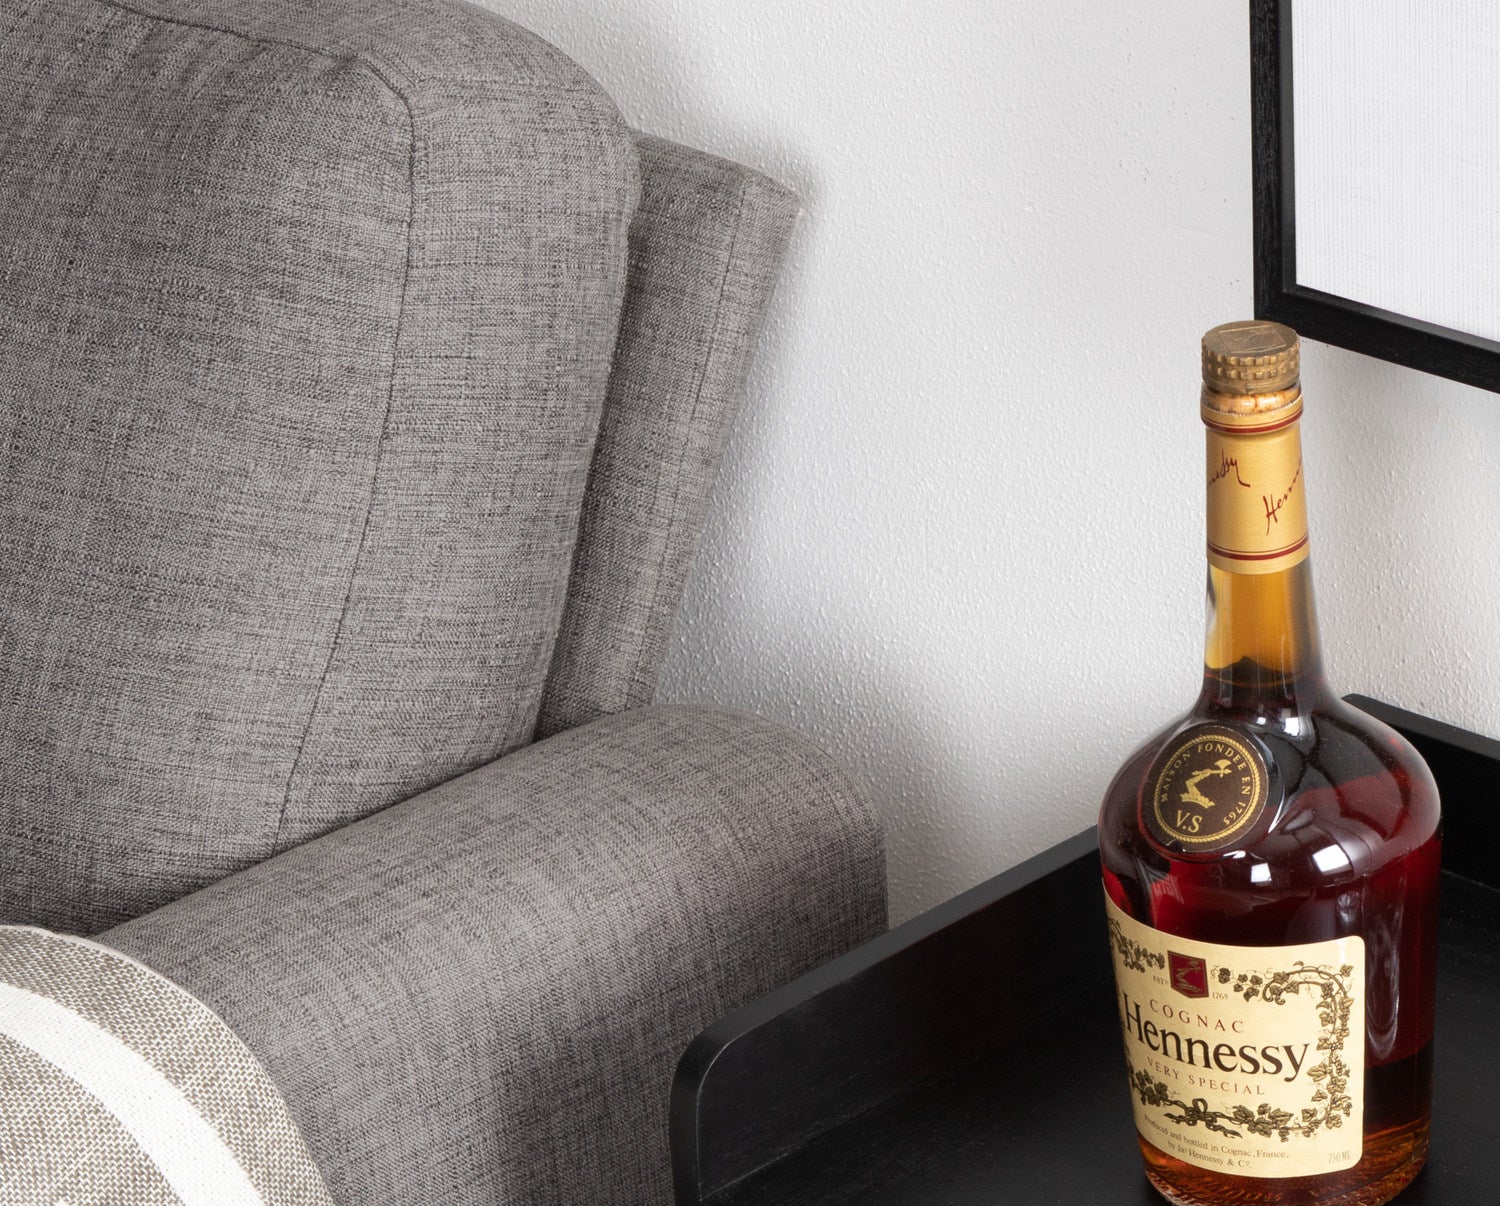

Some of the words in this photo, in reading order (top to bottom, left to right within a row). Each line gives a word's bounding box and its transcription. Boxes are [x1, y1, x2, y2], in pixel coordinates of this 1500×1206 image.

[1197, 742, 1247, 771] FONDEE
[1160, 750, 1191, 803] MAISON
[1241, 776, 1251, 795] EN
[1223, 801, 1246, 825] 1765
[1149, 998, 1244, 1033] COGNAC
[1122, 990, 1310, 1083] Hennessy
[1146, 1056, 1181, 1080] VERY
[1188, 1074, 1265, 1095] SPECIAL
[1169, 1131, 1182, 1141] and
[1183, 1135, 1209, 1149] bottled
[1188, 1148, 1225, 1166] Hennessy
